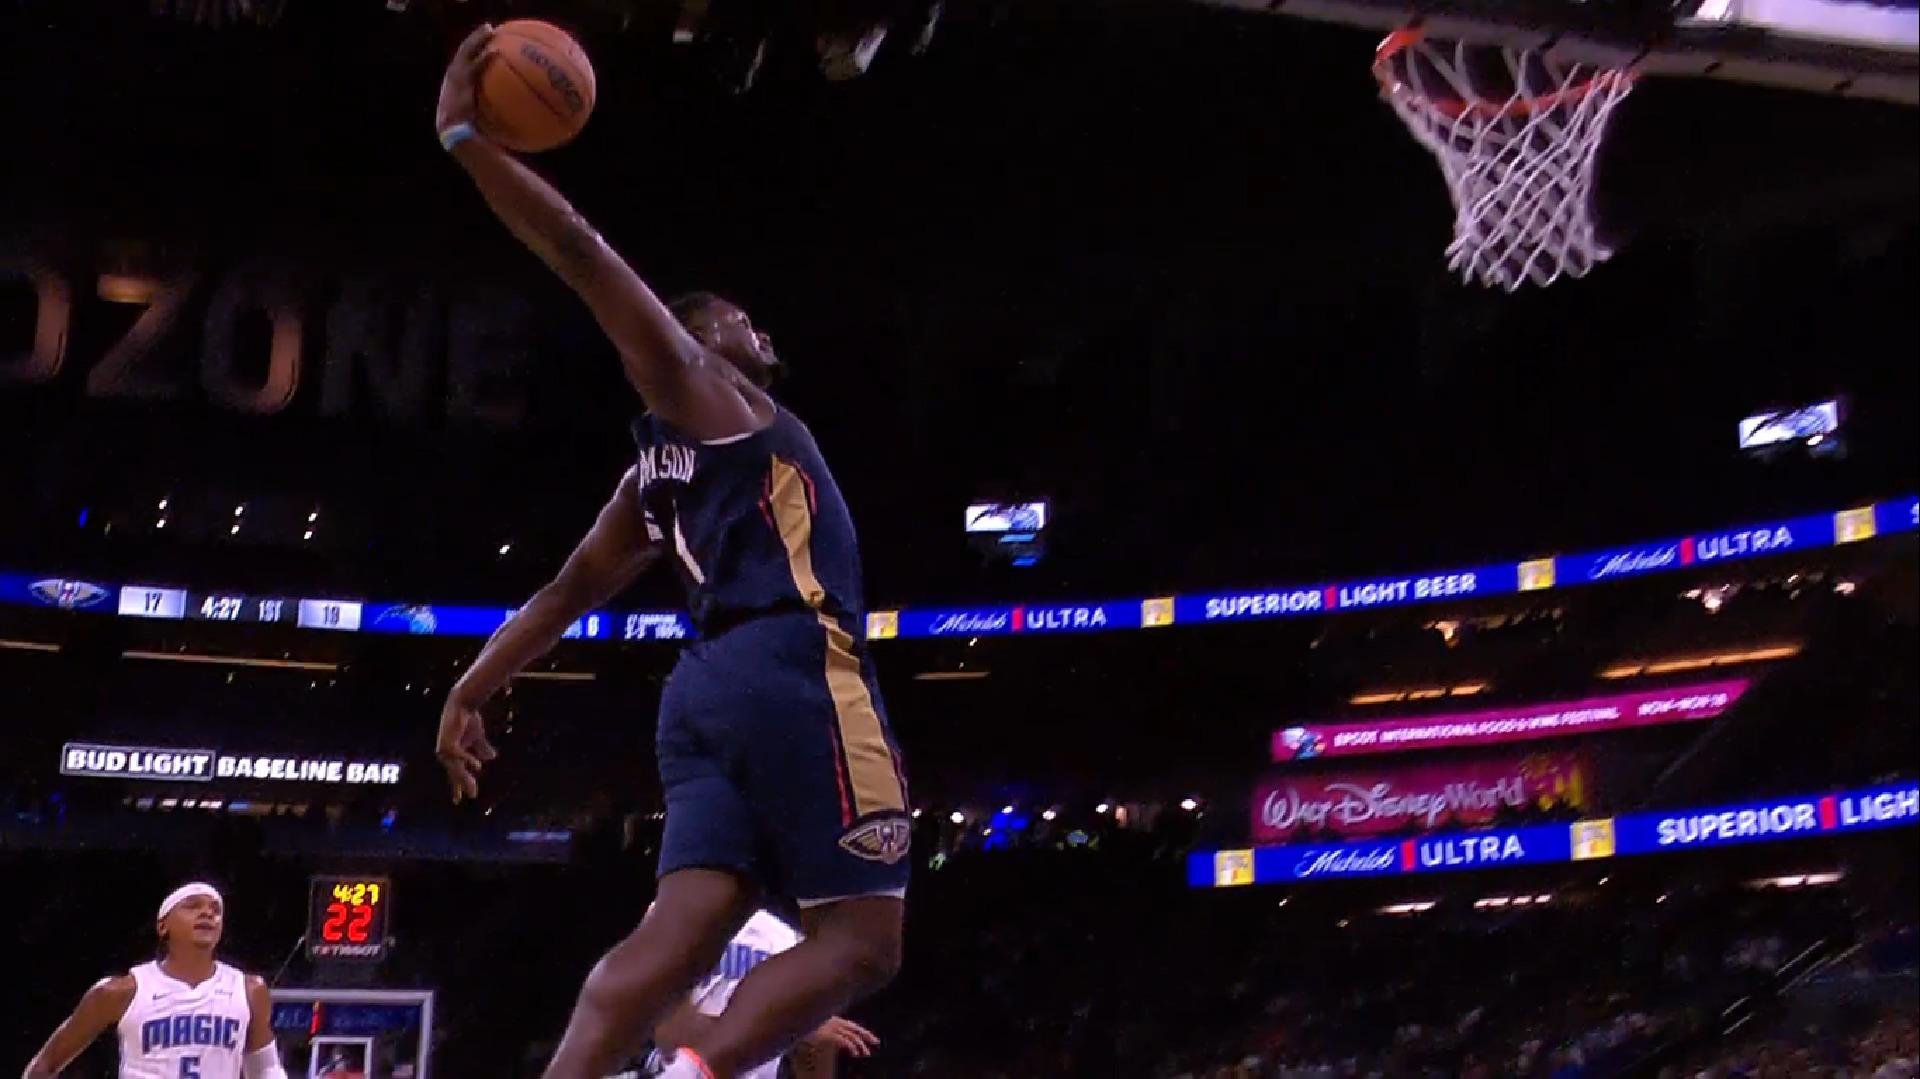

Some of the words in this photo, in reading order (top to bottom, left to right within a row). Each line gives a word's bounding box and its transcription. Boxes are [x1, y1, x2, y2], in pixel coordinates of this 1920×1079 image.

[1697, 525, 1794, 560] ULTRA
[1205, 589, 1322, 619] SUPERIOR
[1340, 580, 1411, 608] LIGHT
[1414, 572, 1477, 599] BEER
[1026, 606, 1107, 630] ULTRA
[66, 749, 126, 771] BUD
[128, 751, 209, 775] LIGHT
[217, 755, 344, 781] BASELINE
[346, 762, 400, 784] BAR
[1656, 803, 1817, 846] SUPERIOR
[1840, 788, 1919, 826] LIGH
[1294, 845, 1398, 878] Michelob
[1420, 833, 1525, 867] ULTRA
[333, 883, 379, 906] 4:27
[323, 902, 372, 942] 22
[141, 1013, 240, 1055] MAGIC
